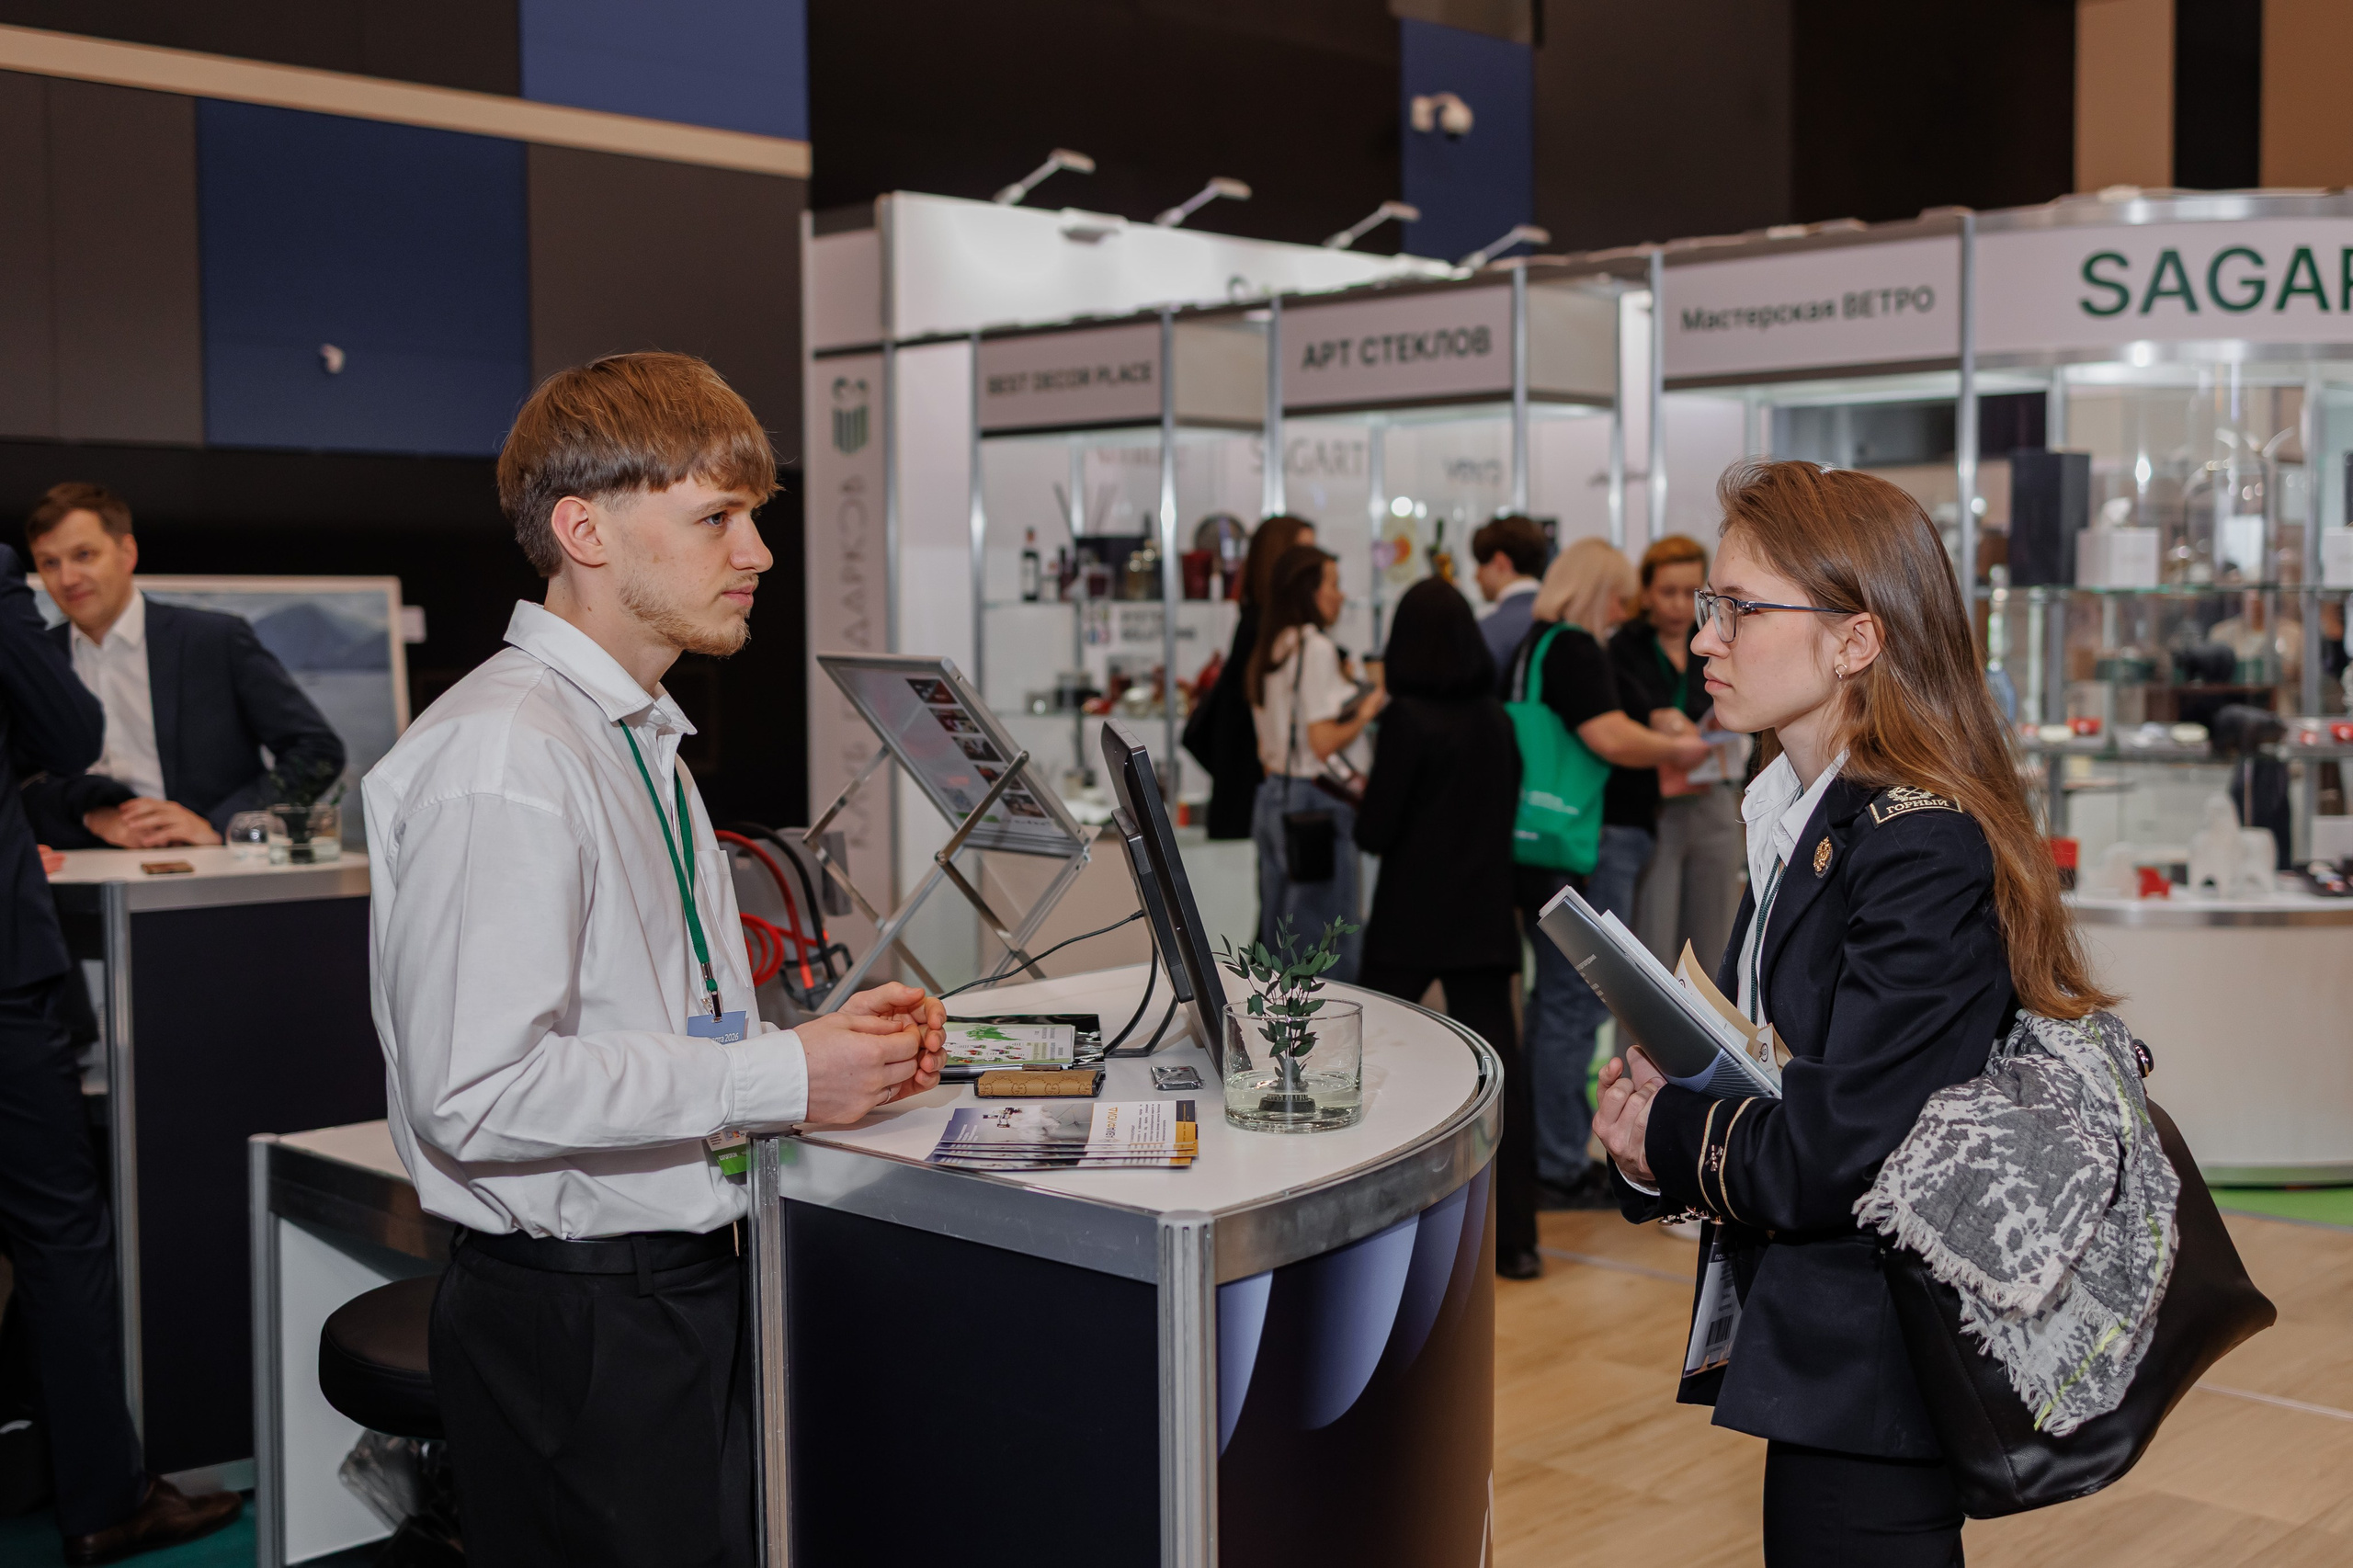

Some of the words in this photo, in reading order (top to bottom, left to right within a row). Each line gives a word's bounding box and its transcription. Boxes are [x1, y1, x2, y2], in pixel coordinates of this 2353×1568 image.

[2079, 244, 2353, 317] SAGA
[1681, 298, 1837, 333] Мастерская
[1842, 285, 1937, 319] ВЕТРО
[1300, 336, 1353, 371] АРТ
[1358, 324, 1493, 367] СТЕКЛОВ
[986, 372, 1028, 397] BEST
[1032, 367, 1090, 395] DECOR
[1096, 360, 1152, 385] PLACE
[1249, 437, 1363, 476] SGART
[837, 474, 871, 722] ПДАРКОВ
[1886, 799, 1949, 814] ГОРНЫЙ
[725, 1032, 739, 1042] 2026
